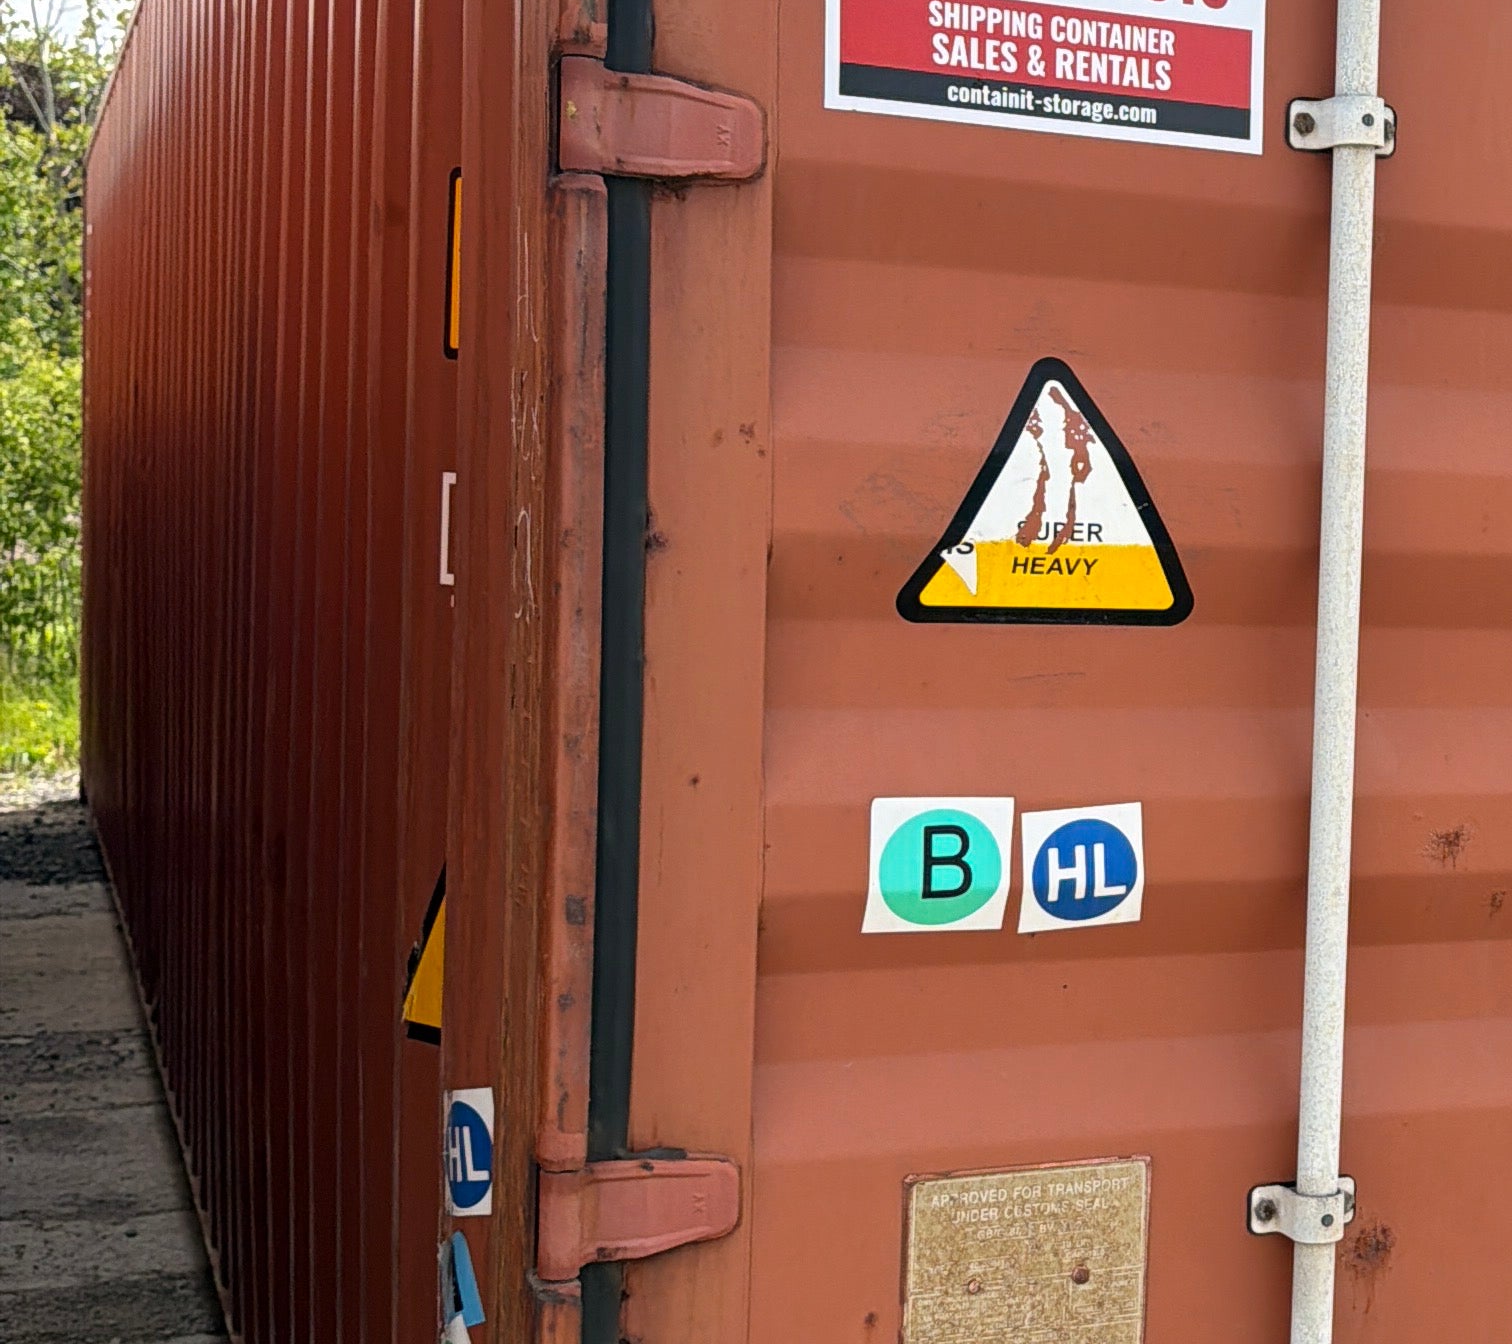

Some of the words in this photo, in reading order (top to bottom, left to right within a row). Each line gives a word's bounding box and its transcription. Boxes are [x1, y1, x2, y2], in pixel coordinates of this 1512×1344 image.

[928, 0, 1043, 39] SHIPPING
[1051, 17, 1176, 57] CONTAINER
[932, 34, 1021, 73] SALES
[1027, 47, 1046, 78] &
[1055, 49, 1172, 91] RENTALS
[947, 84, 1157, 125] containit-storage.com
[1017, 520, 1103, 542] UPER
[1011, 556, 1099, 576] HEAVY
[921, 824, 974, 900] B
[1047, 844, 1128, 904] HL
[1013, 1183, 1042, 1201] FOR
[1048, 1176, 1130, 1197] TRANSPORT
[952, 1205, 999, 1224] UNDER
[1076, 1197, 1110, 1213] SEAL
